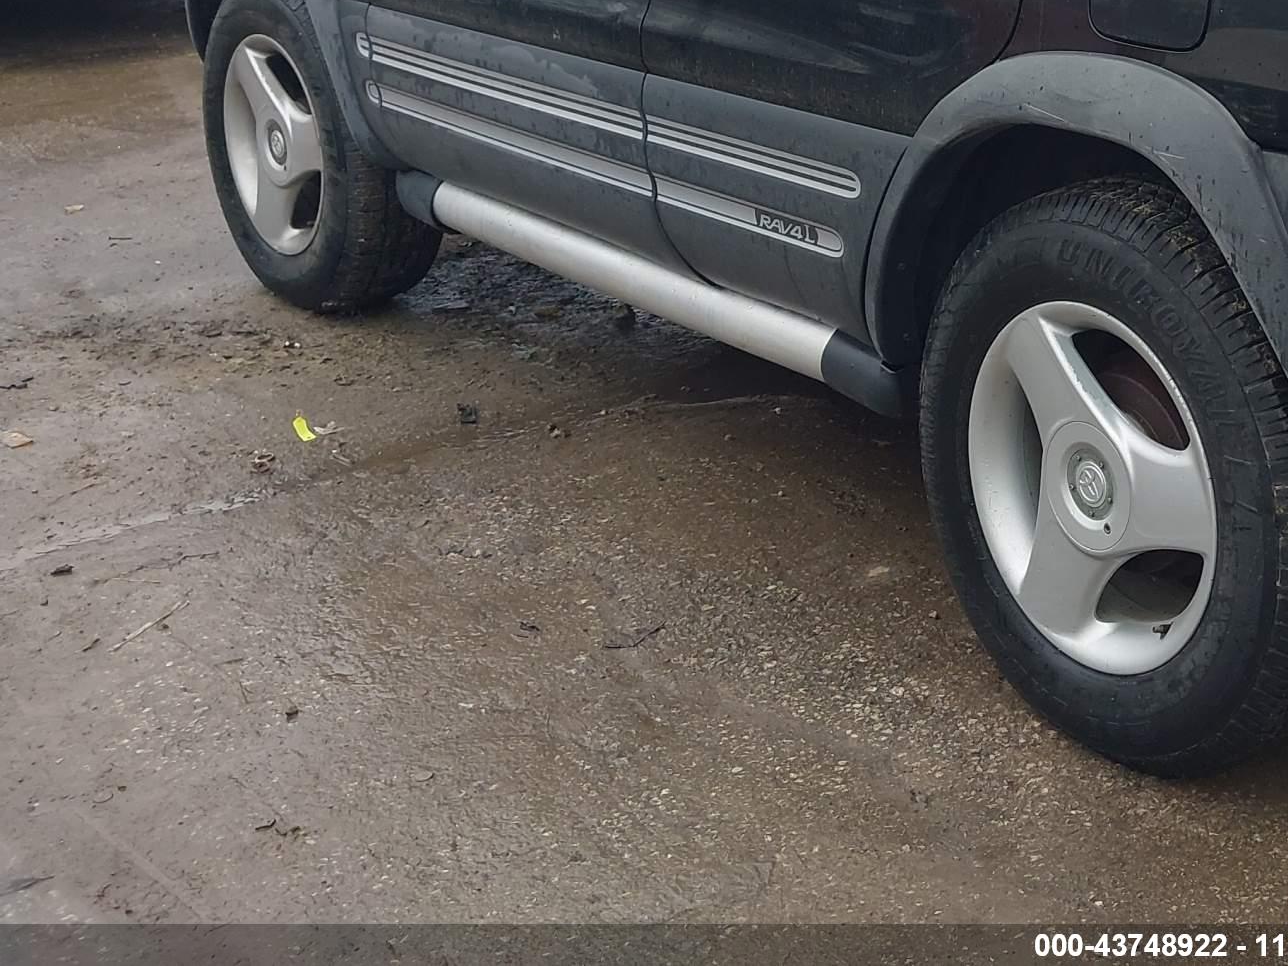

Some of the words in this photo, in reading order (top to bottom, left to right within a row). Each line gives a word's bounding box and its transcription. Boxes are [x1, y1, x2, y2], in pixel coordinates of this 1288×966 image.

[760, 215, 803, 239] RAV4
[804, 224, 815, 242] L
[1057, 240, 1232, 426] UNIROYAL
